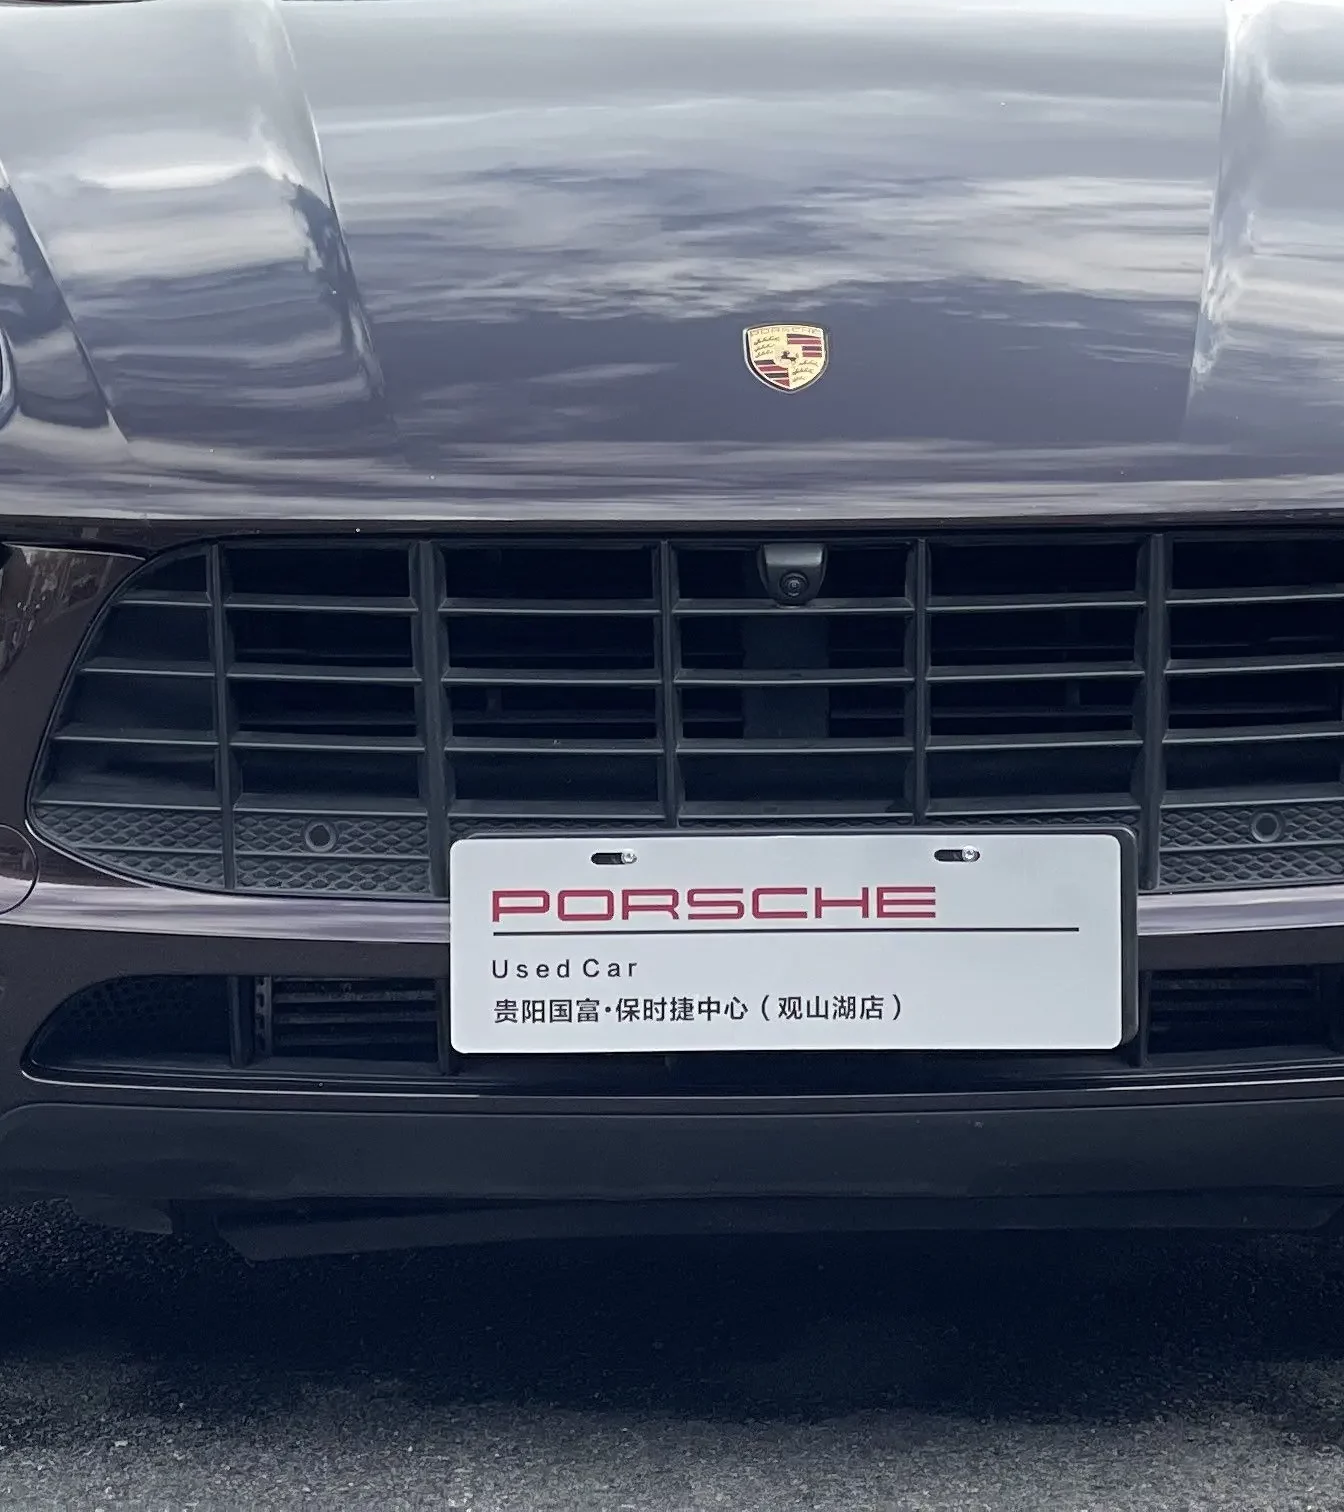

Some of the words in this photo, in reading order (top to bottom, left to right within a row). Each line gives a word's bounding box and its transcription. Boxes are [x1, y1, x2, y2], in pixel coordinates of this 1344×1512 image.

[492, 886, 936, 922] PORSCHE
[492, 958, 570, 979] Used
[582, 958, 638, 978] Car
